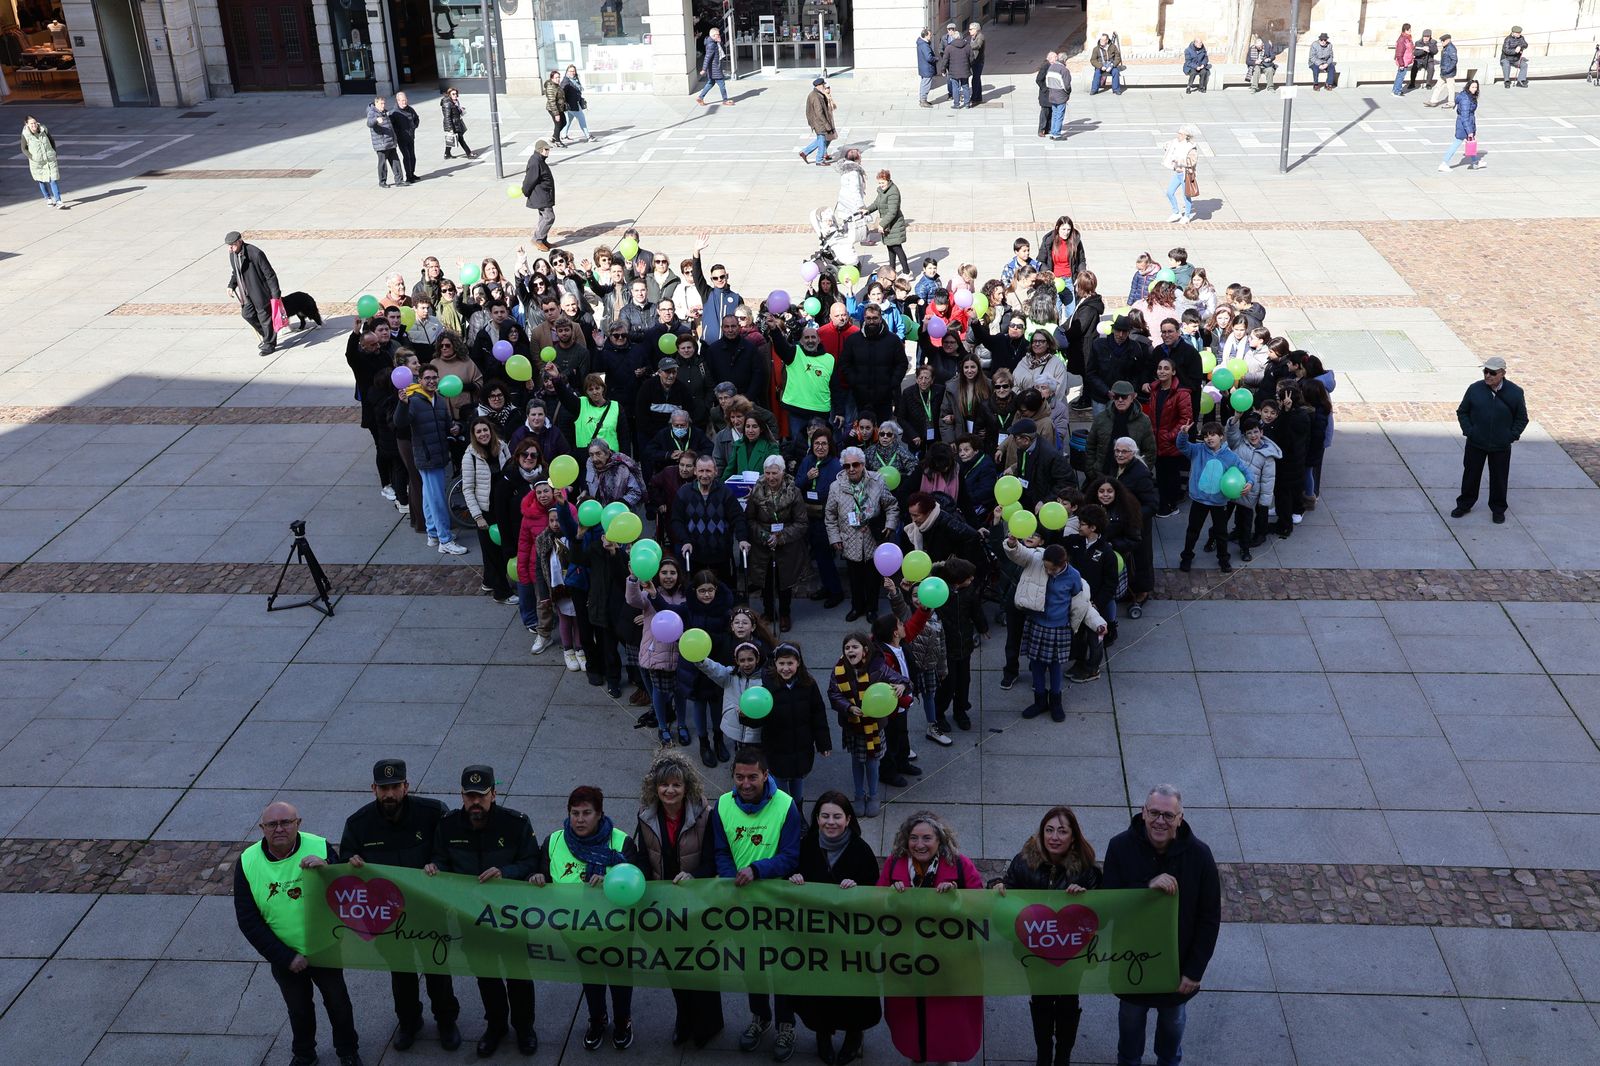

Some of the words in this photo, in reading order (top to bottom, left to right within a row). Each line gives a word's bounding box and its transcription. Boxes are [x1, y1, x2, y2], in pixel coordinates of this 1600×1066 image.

[334, 889, 368, 903] WE
[339, 904, 392, 920] LOVE
[474, 900, 689, 932] ASOCIACIÓN
[700, 906, 903, 937] CORRIENDO
[914, 916, 991, 942] CON
[380, 912, 464, 966] hugo
[1023, 919, 1059, 934] WE
[1028, 932, 1082, 948] LOVE
[526, 942, 566, 963] EL
[576, 940, 746, 971] CORAZÓN
[758, 946, 829, 972] POR
[840, 949, 940, 976] HUGO
[1075, 934, 1162, 985] hugo
